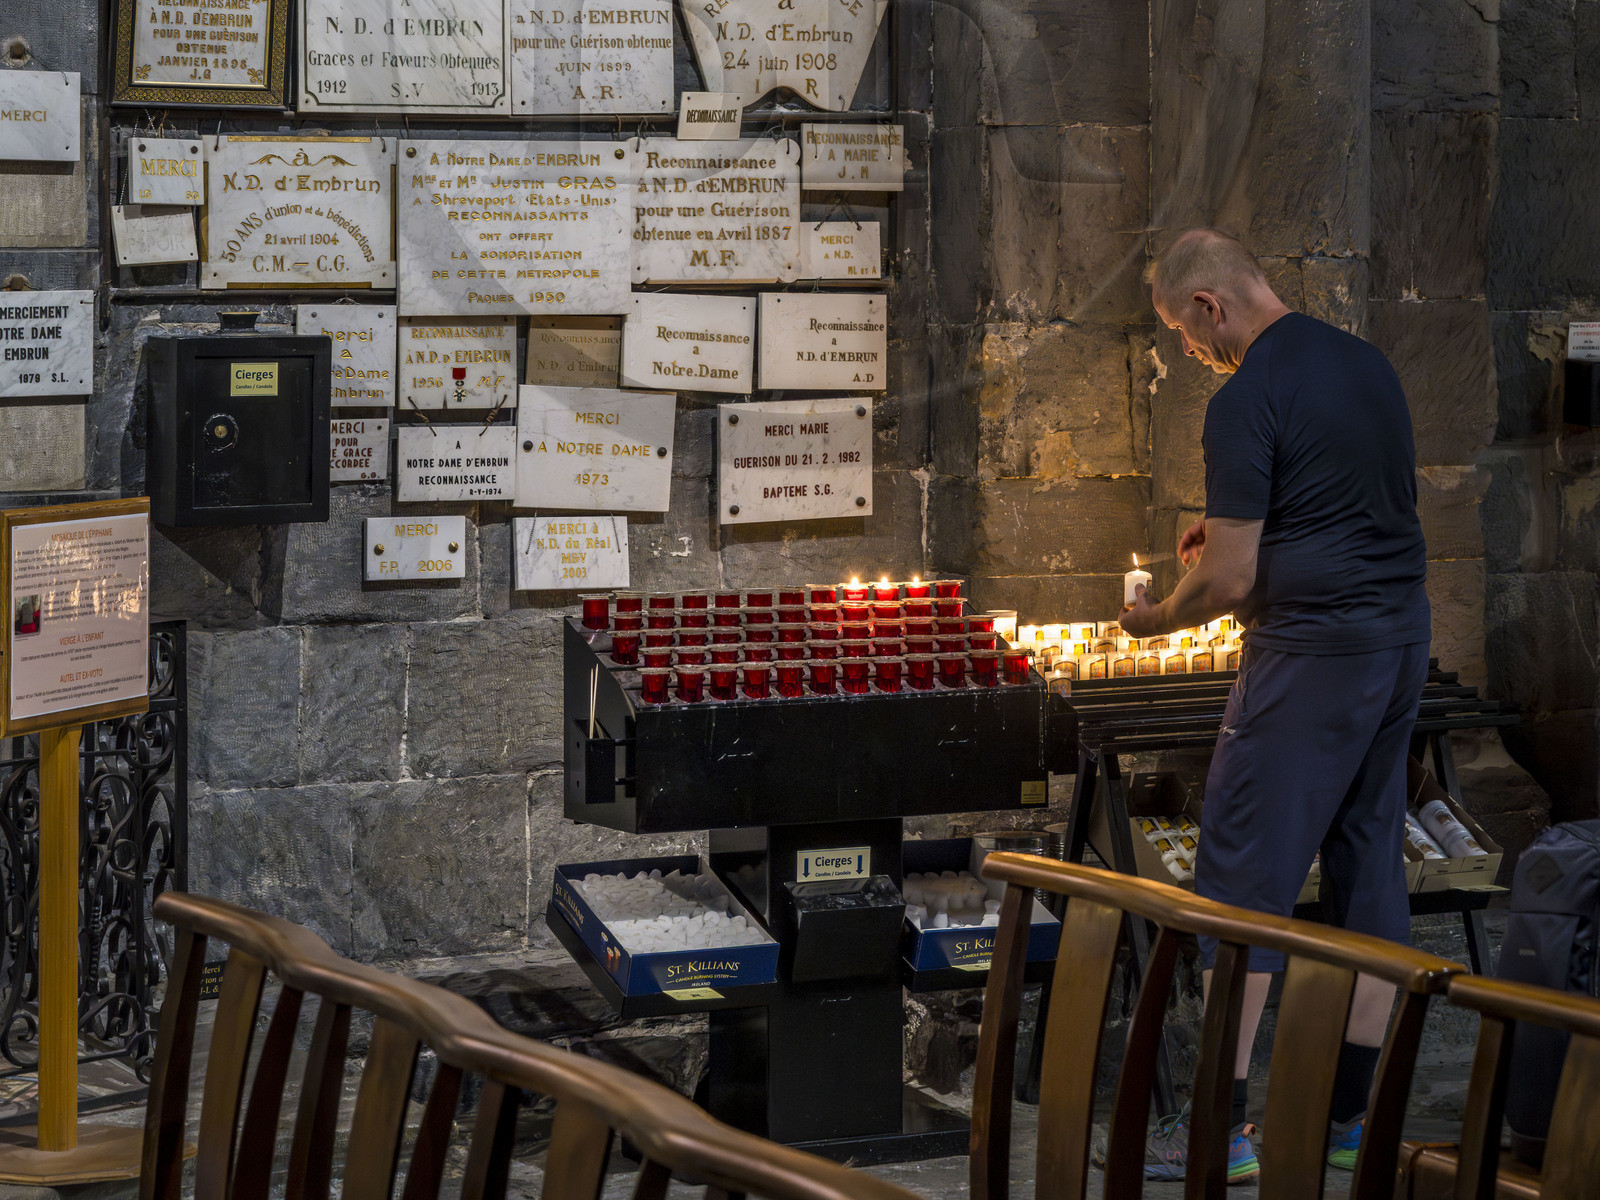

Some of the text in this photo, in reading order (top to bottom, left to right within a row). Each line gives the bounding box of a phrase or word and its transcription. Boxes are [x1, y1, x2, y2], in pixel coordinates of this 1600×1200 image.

[193, 9, 252, 28] D'EMBRUN
[573, 10, 670, 24] d'EMBRUN
[152, 28, 180, 40] POUR
[765, 24, 853, 44] d'Embrun
[570, 34, 624, 49] Guérison
[176, 43, 228, 54] OBTENUE
[157, 56, 208, 67] JANVIER
[308, 50, 500, 70] Graces Faveurs Obtenues
[724, 49, 837, 74] 24 juin 1908
[555, 62, 592, 72] JUIN
[316, 80, 347, 94] 1912
[0, 108, 47, 122] MERCI
[686, 109, 738, 124] RECONNAISSANCE
[806, 130, 901, 146] RECONNAISSANCE
[292, 148, 310, 166] à
[448, 152, 485, 166] NOTRE
[646, 152, 776, 169] Reconnaissance
[844, 150, 879, 162] MARIE
[140, 158, 197, 177] MERCI
[274, 174, 381, 194] d'Embrun
[491, 176, 617, 190] JUSTIN GRAS
[696, 177, 786, 193] d'EMBRUN
[186, 191, 200, 200] SG
[431, 194, 516, 210] Shreveport
[448, 211, 589, 221] RECONNAISSANTS
[710, 202, 790, 218] Guérison
[235, 212, 264, 242] ANS
[632, 226, 792, 240] obtenue Avril 1887
[310, 232, 340, 246] 1904
[509, 232, 554, 240] OFFERT
[821, 235, 854, 244] MERCI
[480, 250, 582, 260] SONORISATION
[457, 270, 600, 279] CETTE METROPOLE
[530, 292, 566, 303] 1950
[810, 318, 884, 334] Reconnaissance
[31, 326, 62, 340] DAME
[411, 326, 504, 340] RECONNAISSANCE
[656, 326, 750, 344] Reconnaissance
[4, 347, 49, 360] EMBRUN
[443, 350, 511, 364] D'EMBRUN
[820, 352, 878, 364] d'EMBRUN
[19, 374, 40, 384] 1979
[236, 370, 274, 382] Cierges
[346, 366, 389, 379] Dame
[412, 377, 444, 389] 1956
[576, 412, 620, 425] MERCI
[332, 422, 366, 434] MERCI
[765, 422, 829, 437] MERCI MARIE
[335, 438, 358, 447] POUR
[556, 442, 651, 456] NOTRE DAME
[344, 448, 372, 458] GRACE
[406, 458, 508, 468] NOTRE DAME D'EMBRUN
[734, 455, 780, 469] GUERISON
[418, 475, 497, 486] RECONNAISSANCE
[576, 474, 609, 486] 1973
[764, 485, 808, 499] BAPTEME
[394, 524, 438, 537] MERCI
[548, 523, 586, 534] MERCI
[586, 536, 610, 549] Réal
[561, 552, 587, 564] M&V
[418, 560, 452, 572] 2006
[562, 567, 588, 579] 2003
[60, 636, 76, 646] VIERGE
[60, 668, 103, 683] AUTEL ET EX-VOTO
[815, 856, 852, 868] Cierges
[668, 960, 740, 978] ST. KILLIANS
